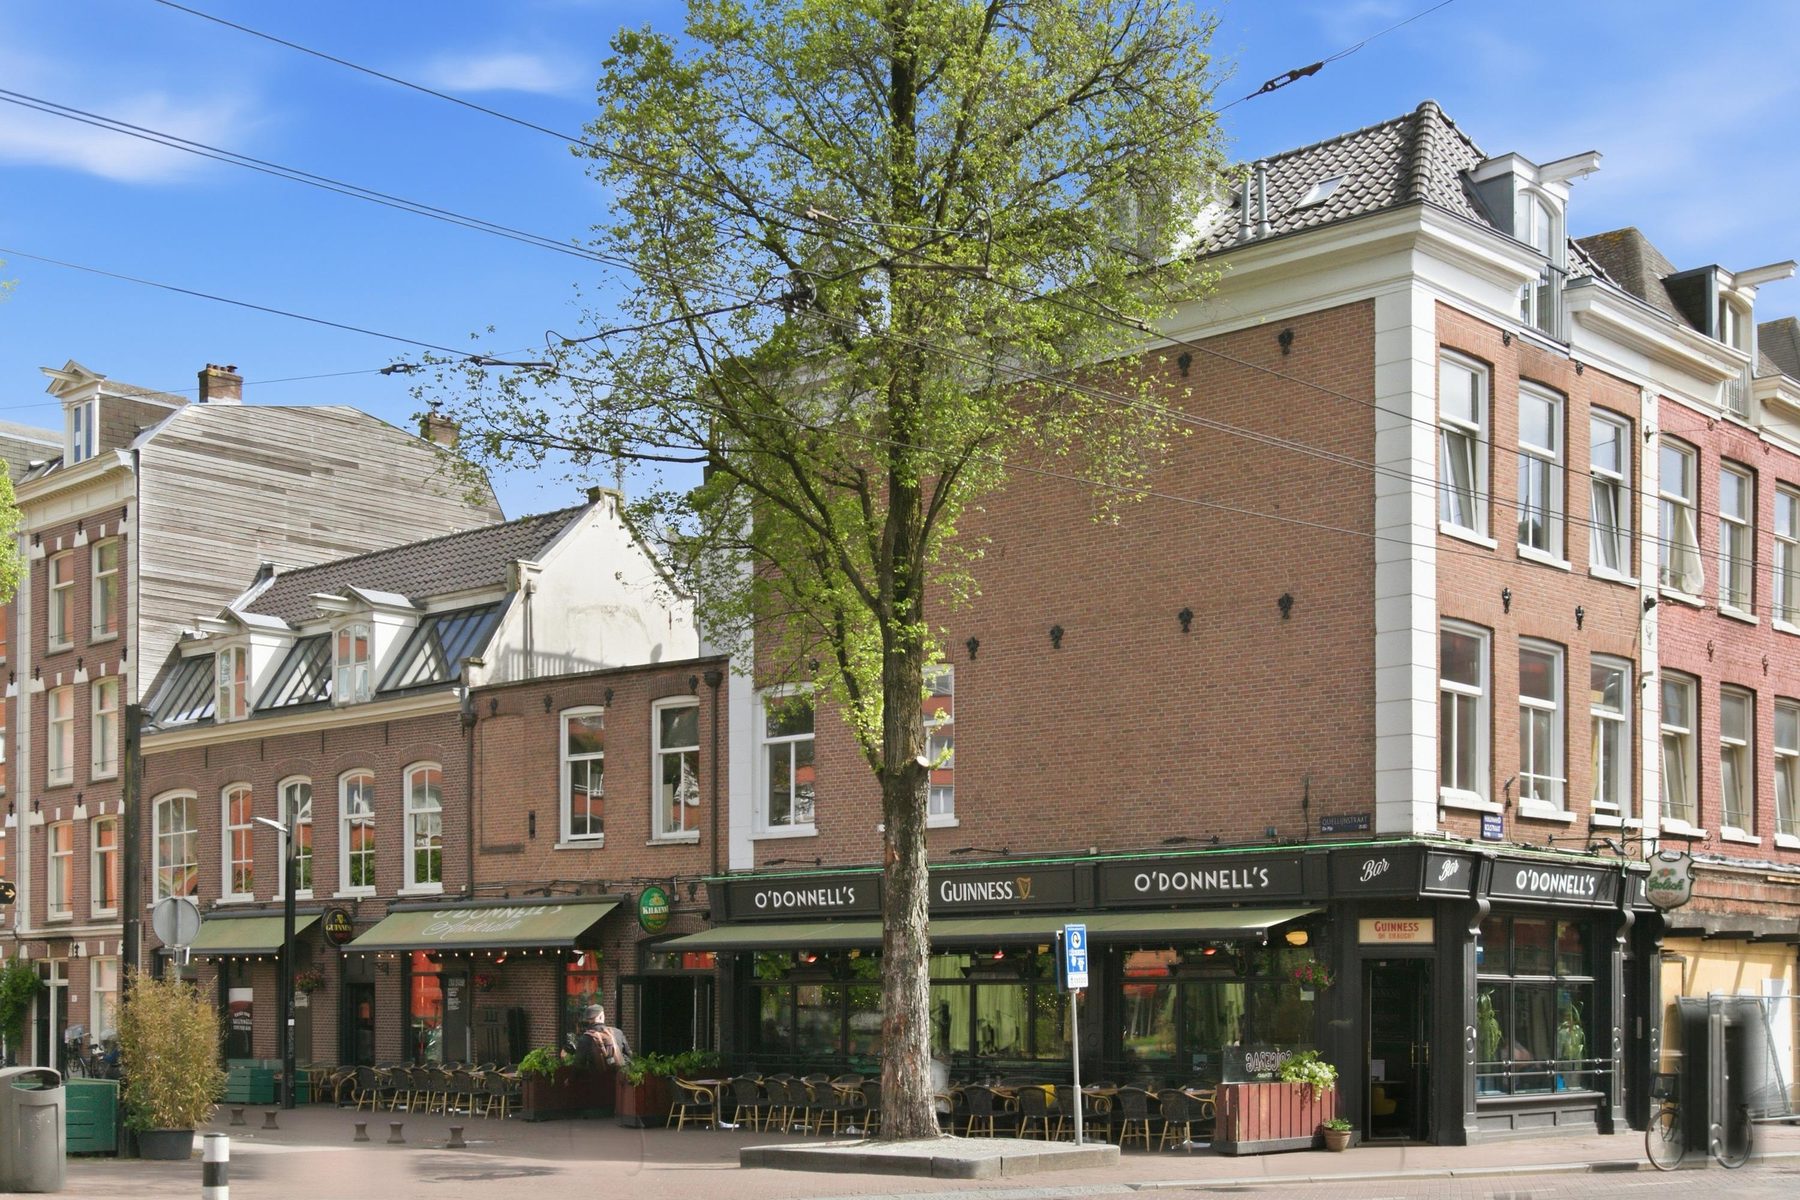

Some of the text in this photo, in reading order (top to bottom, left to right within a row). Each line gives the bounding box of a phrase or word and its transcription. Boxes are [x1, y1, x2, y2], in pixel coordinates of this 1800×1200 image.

[1134, 867, 1269, 892] O'DONNELL'S
[1360, 858, 1390, 881] Bar
[1439, 859, 1459, 881] Bar
[940, 880, 1013, 902] GUINNESS
[1516, 869, 1595, 895] O'DONNELL'S
[755, 886, 855, 908] O'DONNELL'S
[1374, 921, 1419, 932] GUINNESS
